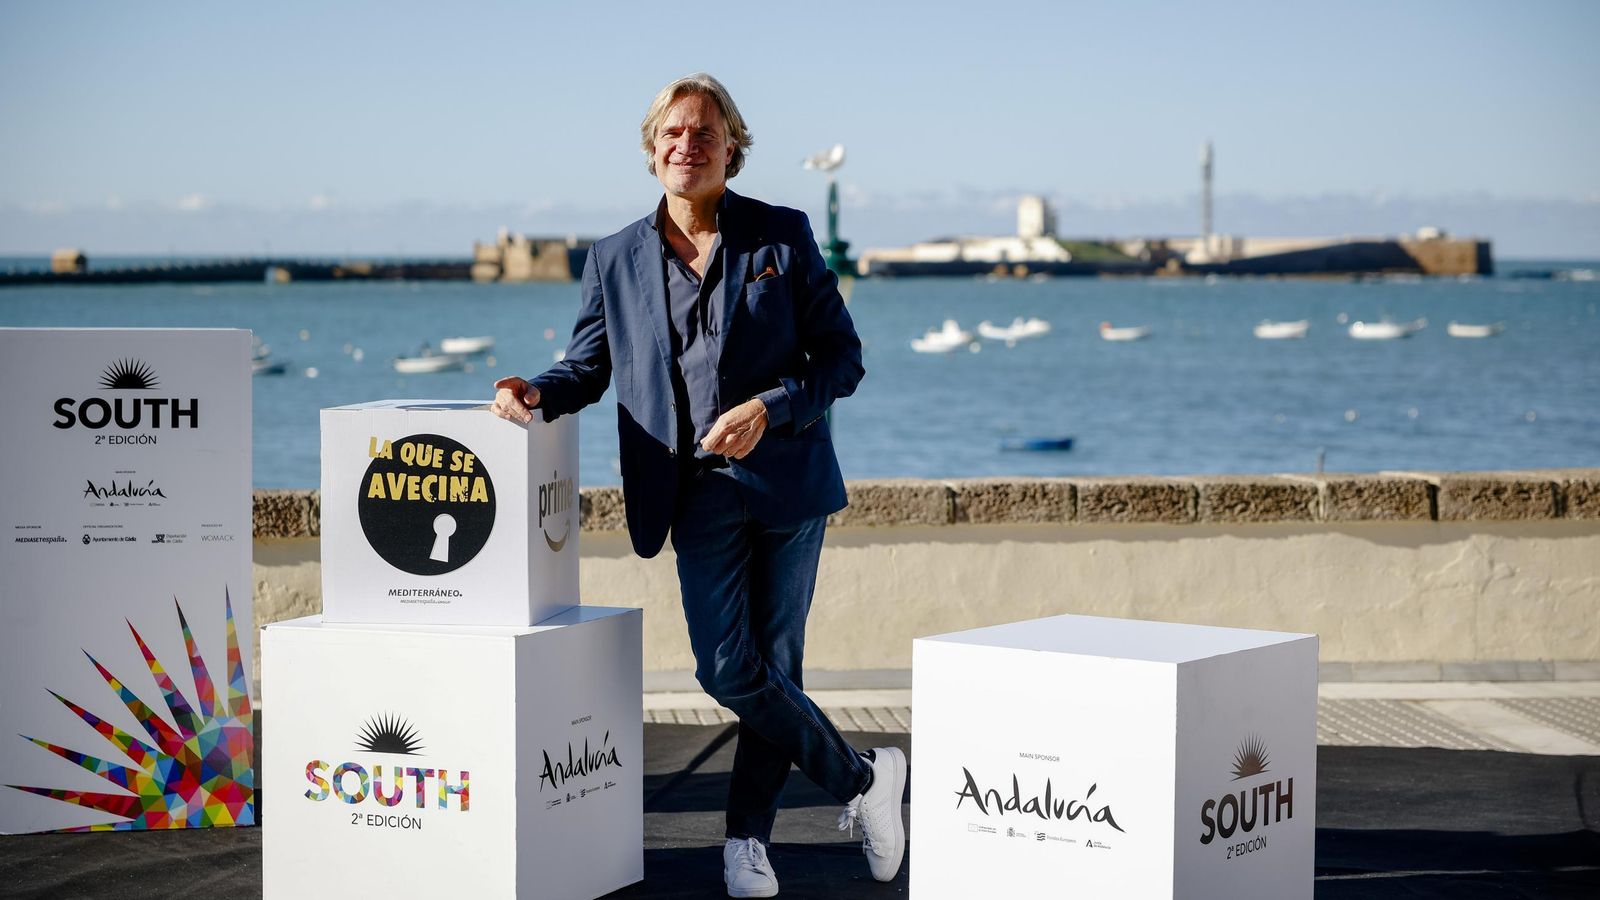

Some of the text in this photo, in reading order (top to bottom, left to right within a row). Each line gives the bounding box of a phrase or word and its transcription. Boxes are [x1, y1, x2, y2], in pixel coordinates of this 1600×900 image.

[52, 397, 199, 429] SOUTH
[95, 433, 157, 445] 2ª EDICIÓN
[368, 436, 475, 473] LA QUE SE
[82, 479, 168, 500] Andalucía
[367, 472, 489, 503] AVECINA
[538, 469, 573, 529] prime
[539, 729, 623, 792] Andalucía
[304, 760, 470, 812] SOUTH
[954, 766, 1127, 834] Andalucía
[351, 812, 422, 830] 2ª EDICIÓN
[1200, 777, 1293, 845] SOUTH
[1236, 835, 1267, 856] EDICIÓN
